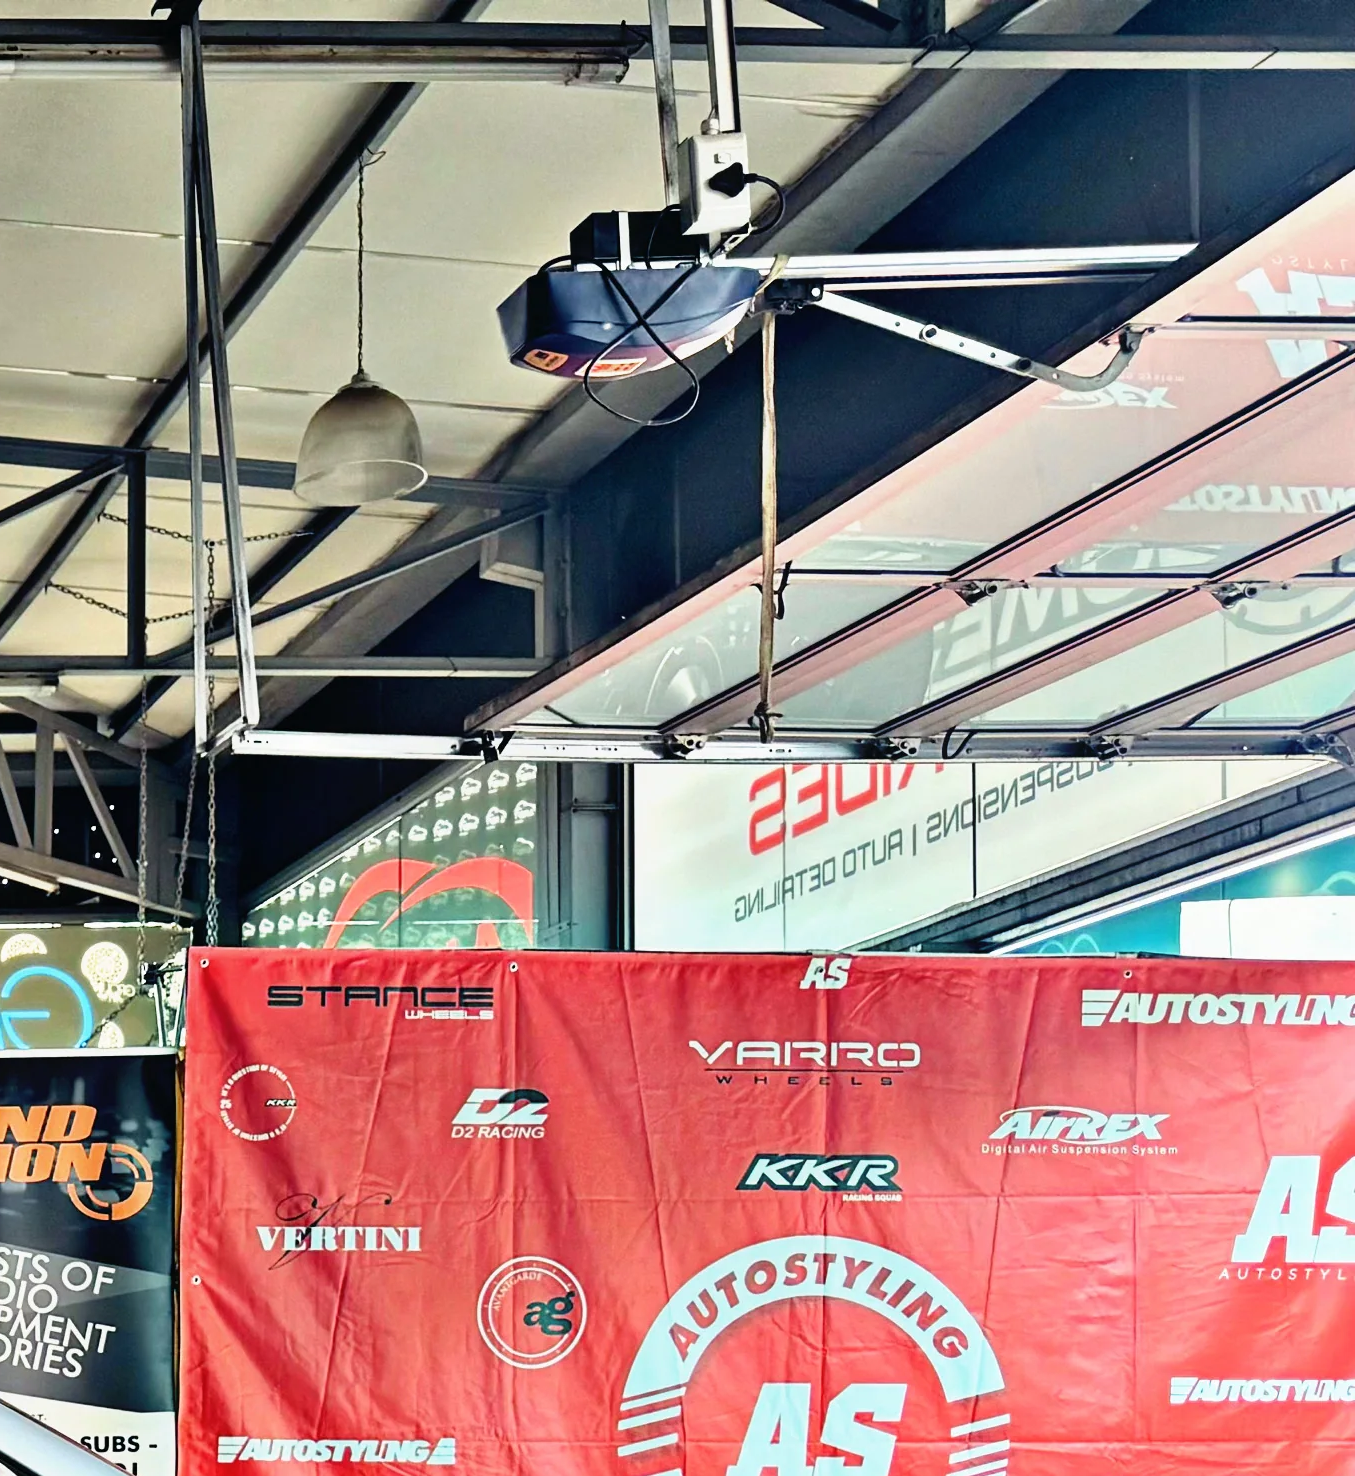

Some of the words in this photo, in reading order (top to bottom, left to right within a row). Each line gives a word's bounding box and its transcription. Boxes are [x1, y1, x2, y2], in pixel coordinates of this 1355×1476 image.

[800, 959, 851, 989] AS
[267, 986, 494, 1007] STANCE
[404, 1010, 494, 1020] WHEELS
[716, 1075, 893, 1086] WHEELS
[451, 1088, 549, 1125] D2
[451, 1126, 475, 1139] D2
[478, 1126, 545, 1139] RACING
[981, 1143, 1024, 1155] Digital
[1030, 1143, 1047, 1154] Air
[1051, 1144, 1127, 1156] Suspension
[1132, 1145, 1178, 1156] System
[745, 1158, 895, 1187] KKR
[257, 1226, 422, 1252] VERTINI
[61, 1262, 116, 1294] OF
[1219, 1268, 1347, 1280] AUTOSTYL
[669, 1253, 969, 1362] AUTOSTYLING
[239, 1438, 431, 1463] AUTOSTYLING
